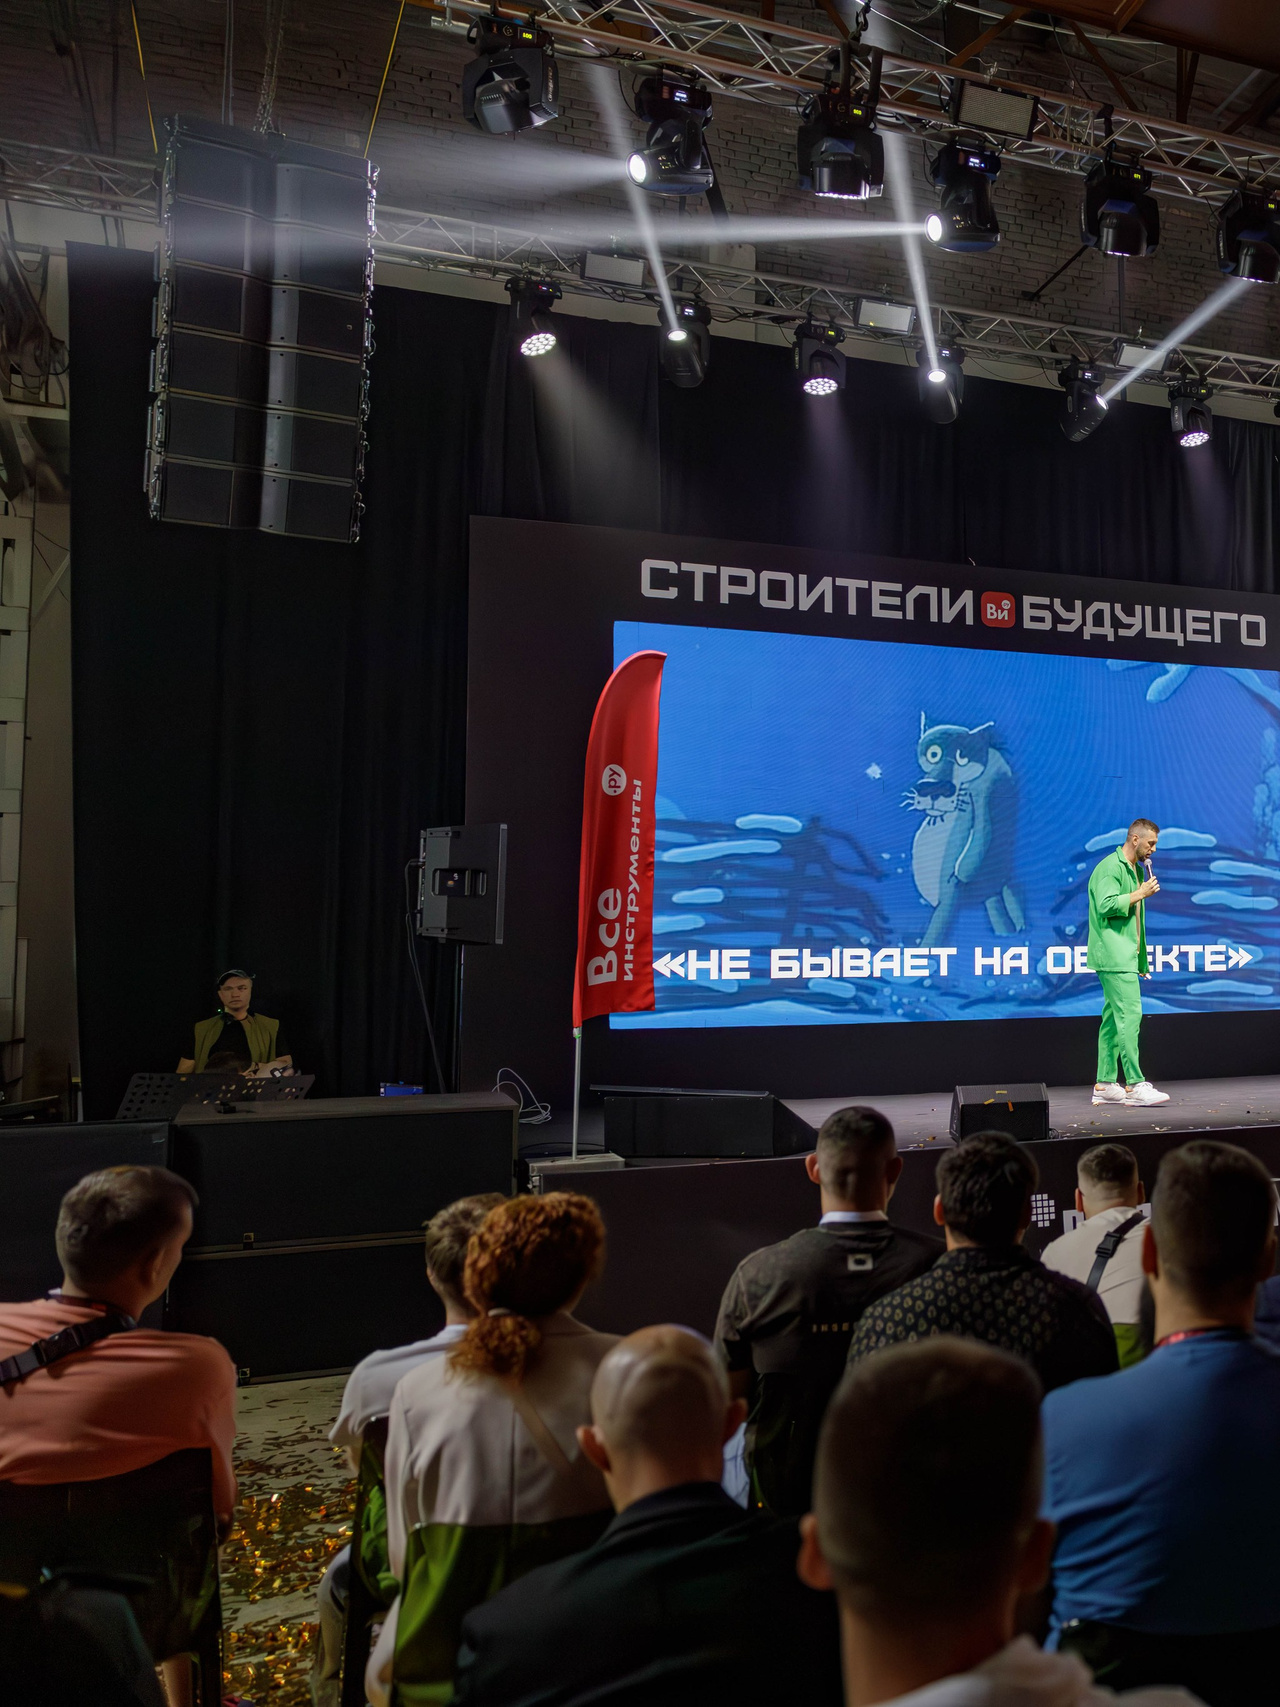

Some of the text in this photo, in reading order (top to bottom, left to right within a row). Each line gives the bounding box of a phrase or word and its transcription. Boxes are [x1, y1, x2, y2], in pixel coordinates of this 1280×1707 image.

[641, 558, 974, 625] СТРОИТЕЛИ
[1022, 594, 1267, 647] БУДУЩЕГО
[623, 779, 642, 981] инструменты
[587, 888, 622, 986] Все
[652, 948, 750, 981] «НЕ
[771, 947, 958, 979] БЫВАЕТ
[974, 946, 1031, 976] НА
